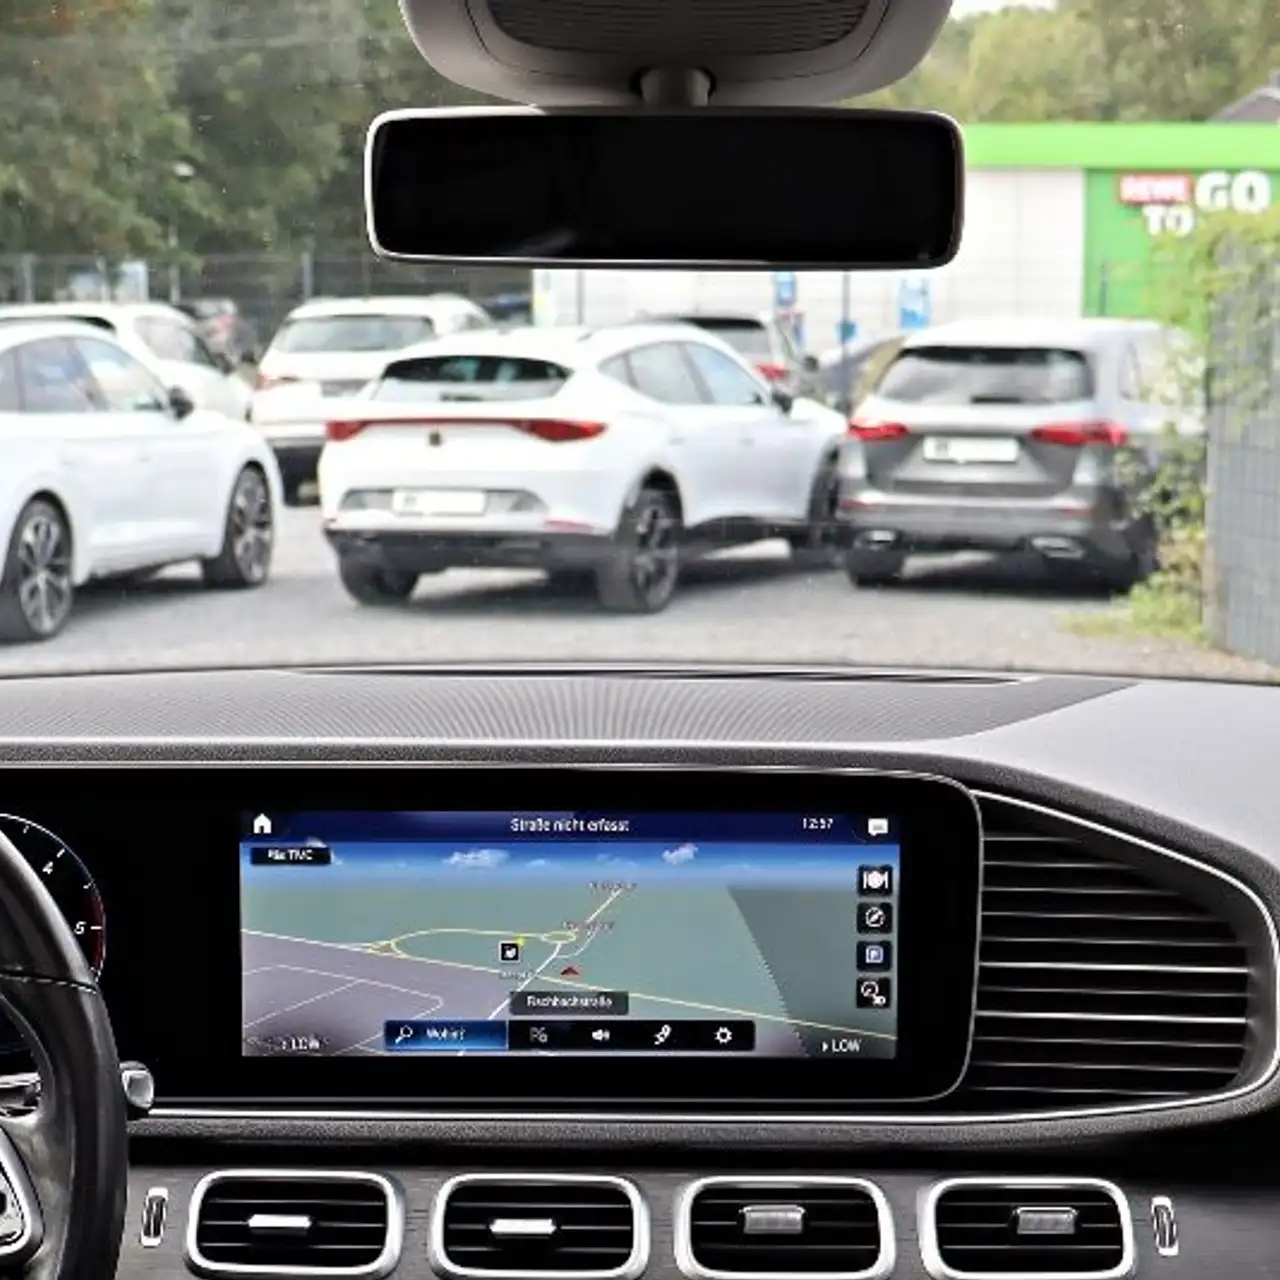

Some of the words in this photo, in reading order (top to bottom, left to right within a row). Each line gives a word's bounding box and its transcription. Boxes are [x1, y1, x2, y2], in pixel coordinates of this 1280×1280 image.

[1196, 171, 1270, 215] GO
[1143, 204, 1194, 237] TO
[511, 818, 550, 831] Straße
[554, 817, 585, 831] nicht
[588, 817, 629, 831] erfasst
[42, 861, 54, 875] 4
[832, 1039, 861, 1052] LOW
